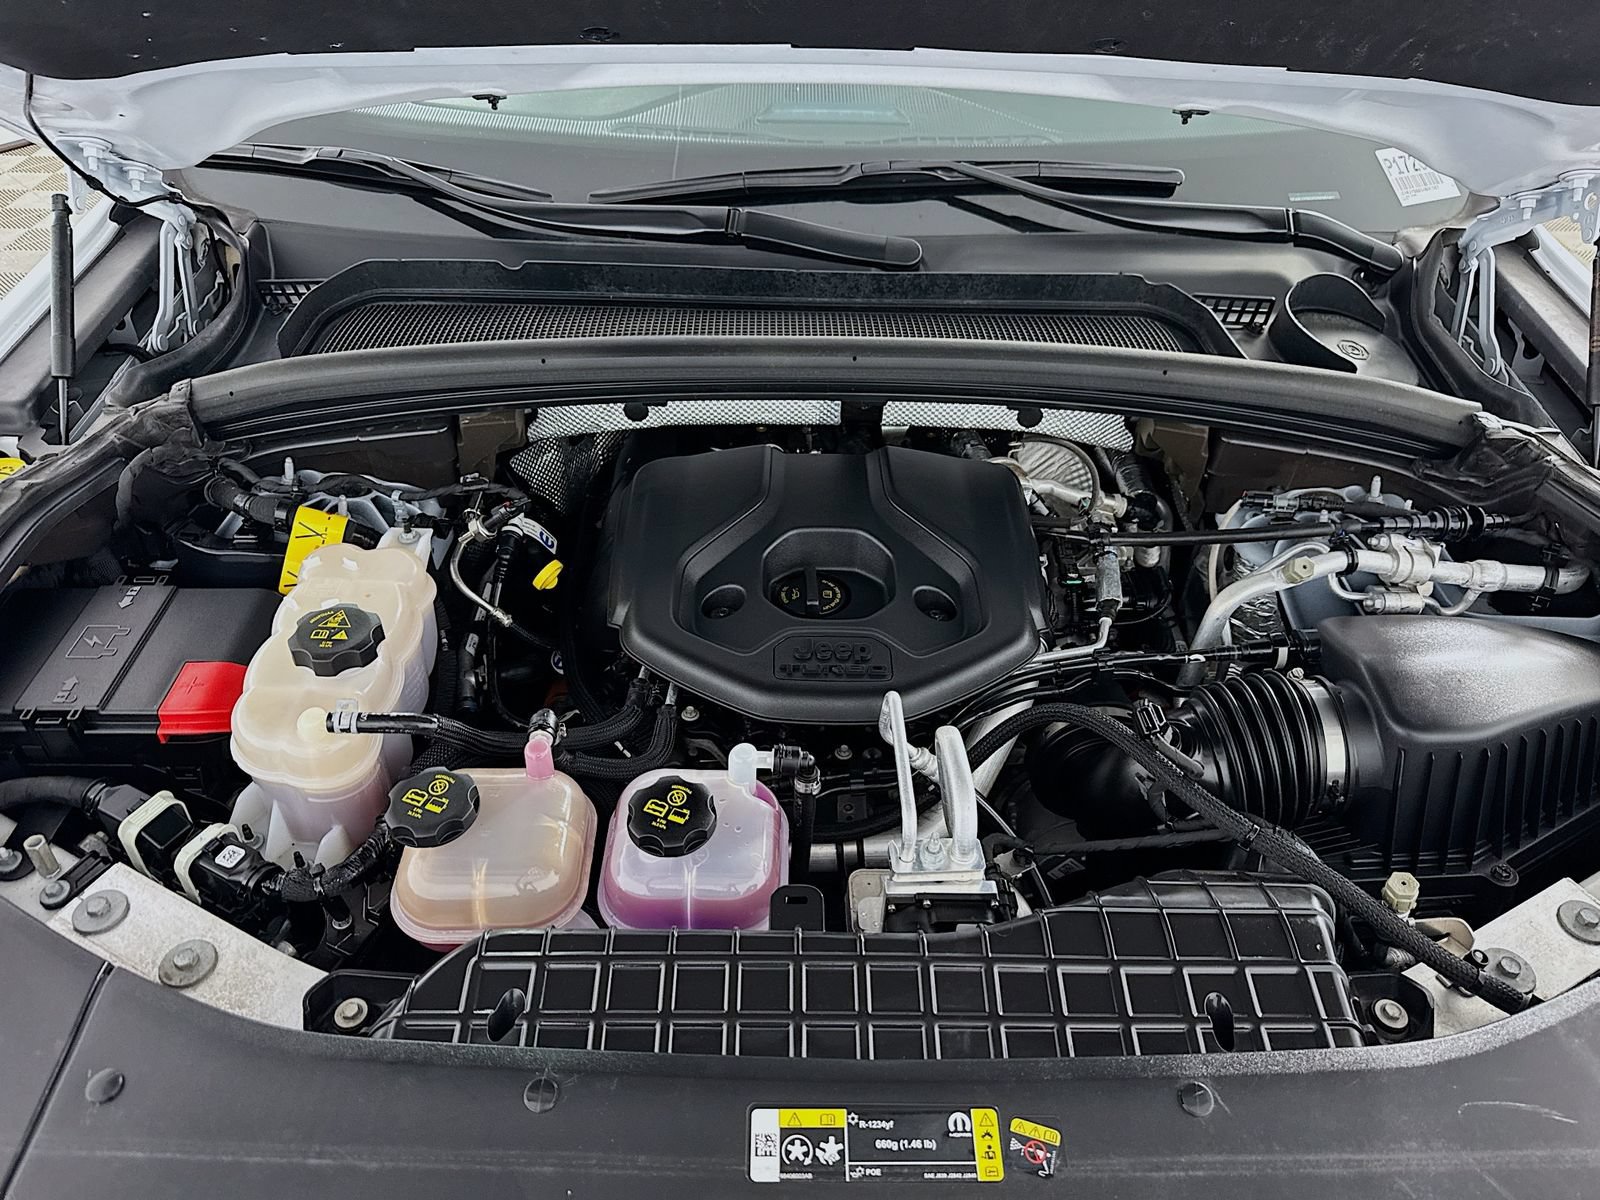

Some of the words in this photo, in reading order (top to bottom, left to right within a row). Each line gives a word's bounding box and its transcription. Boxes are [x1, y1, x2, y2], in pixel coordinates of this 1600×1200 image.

[794, 639, 872, 665] Jeep
[859, 1120, 894, 1130] R-1234yf
[923, 1139, 937, 1150] lb)
